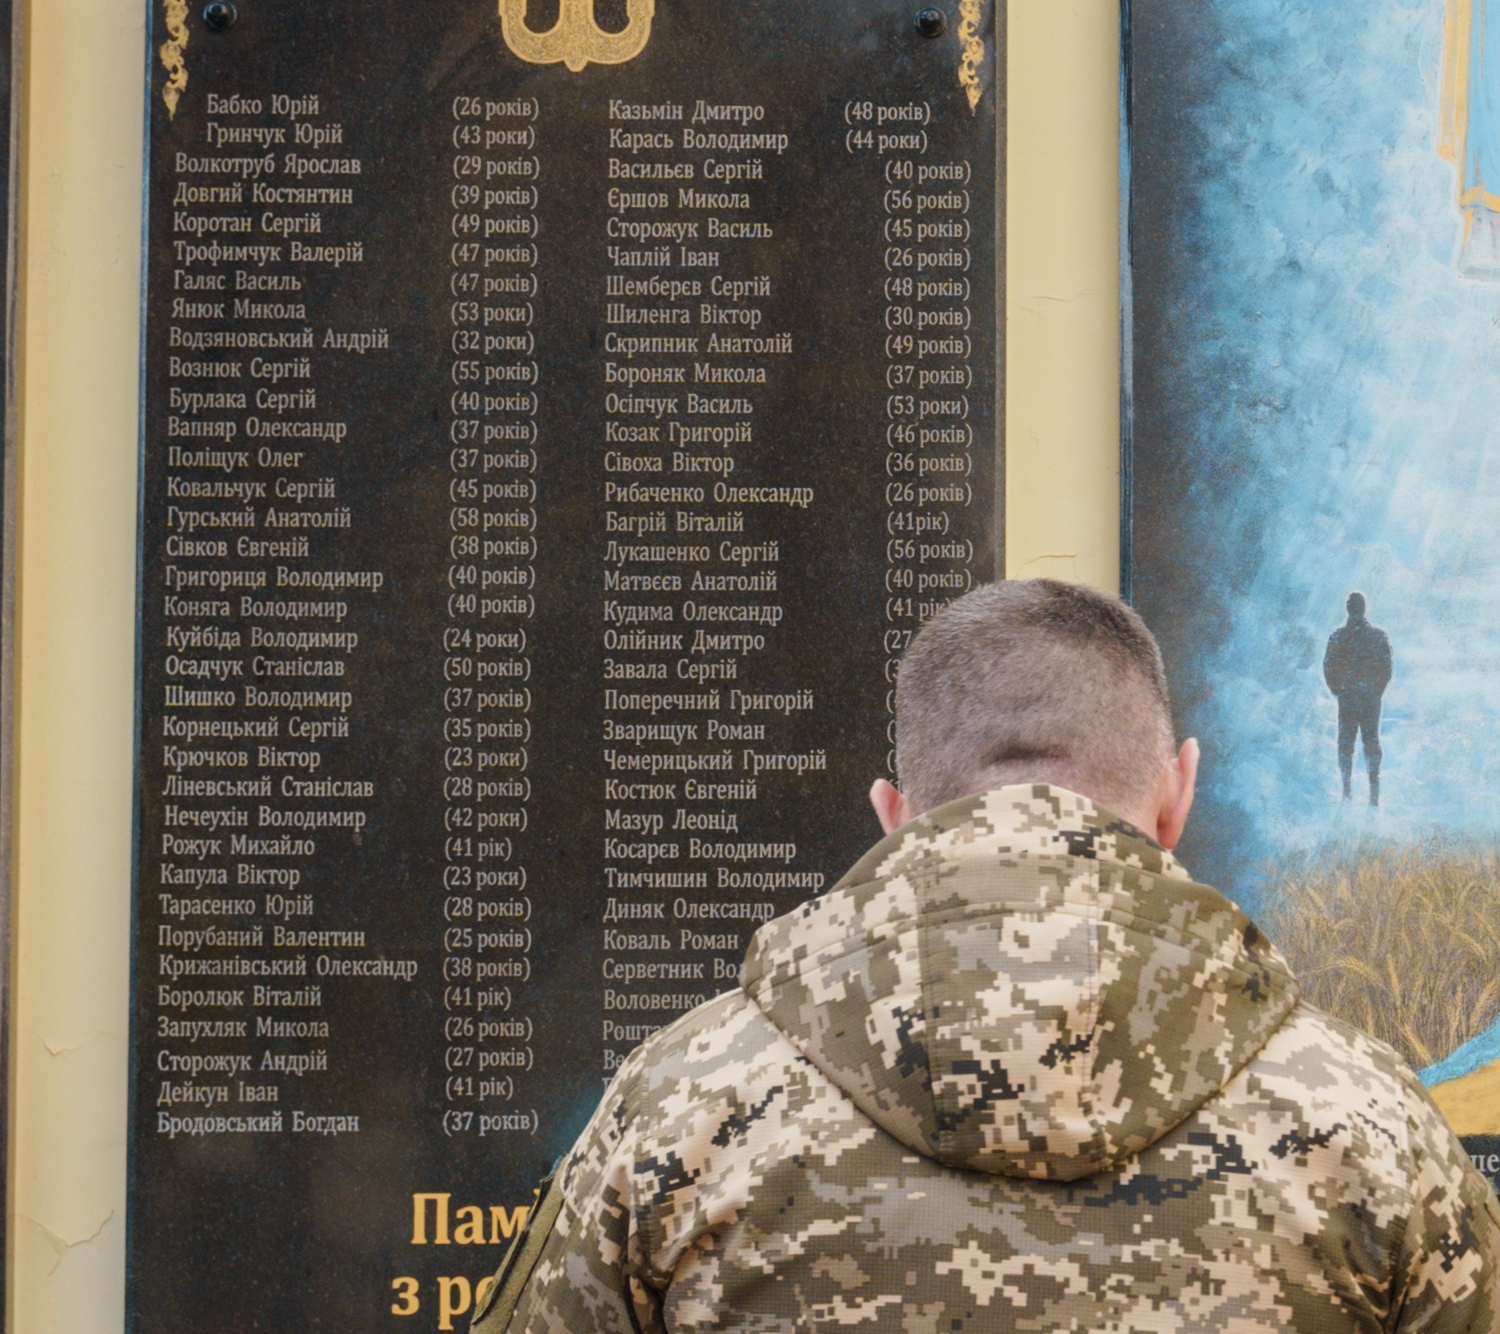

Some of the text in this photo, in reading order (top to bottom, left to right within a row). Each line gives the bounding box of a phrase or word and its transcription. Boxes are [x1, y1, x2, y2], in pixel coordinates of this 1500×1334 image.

[206, 93, 539, 120] Бабко Юрій (26 років)
[608, 99, 931, 125] Казьмін Дмитро (48 років)
[173, 182, 538, 209] Довгий Костянтин (39 років)
[607, 187, 970, 213] Єршов Микола (56 років)
[606, 217, 970, 242] Сторожук Василь (45 років)
[173, 241, 538, 267] Трофимчук Валерій (47 років)
[605, 422, 973, 447] Козак Григорій (46 років)
[164, 685, 531, 712] Шишко Володимир (37 років)
[161, 834, 511, 861] Рожук Михайло (41 рік)
[156, 1109, 538, 1138] Бродовський Богдан (37 років)
[410, 1188, 539, 1244] Пам
[390, 1275, 420, 1315] з
